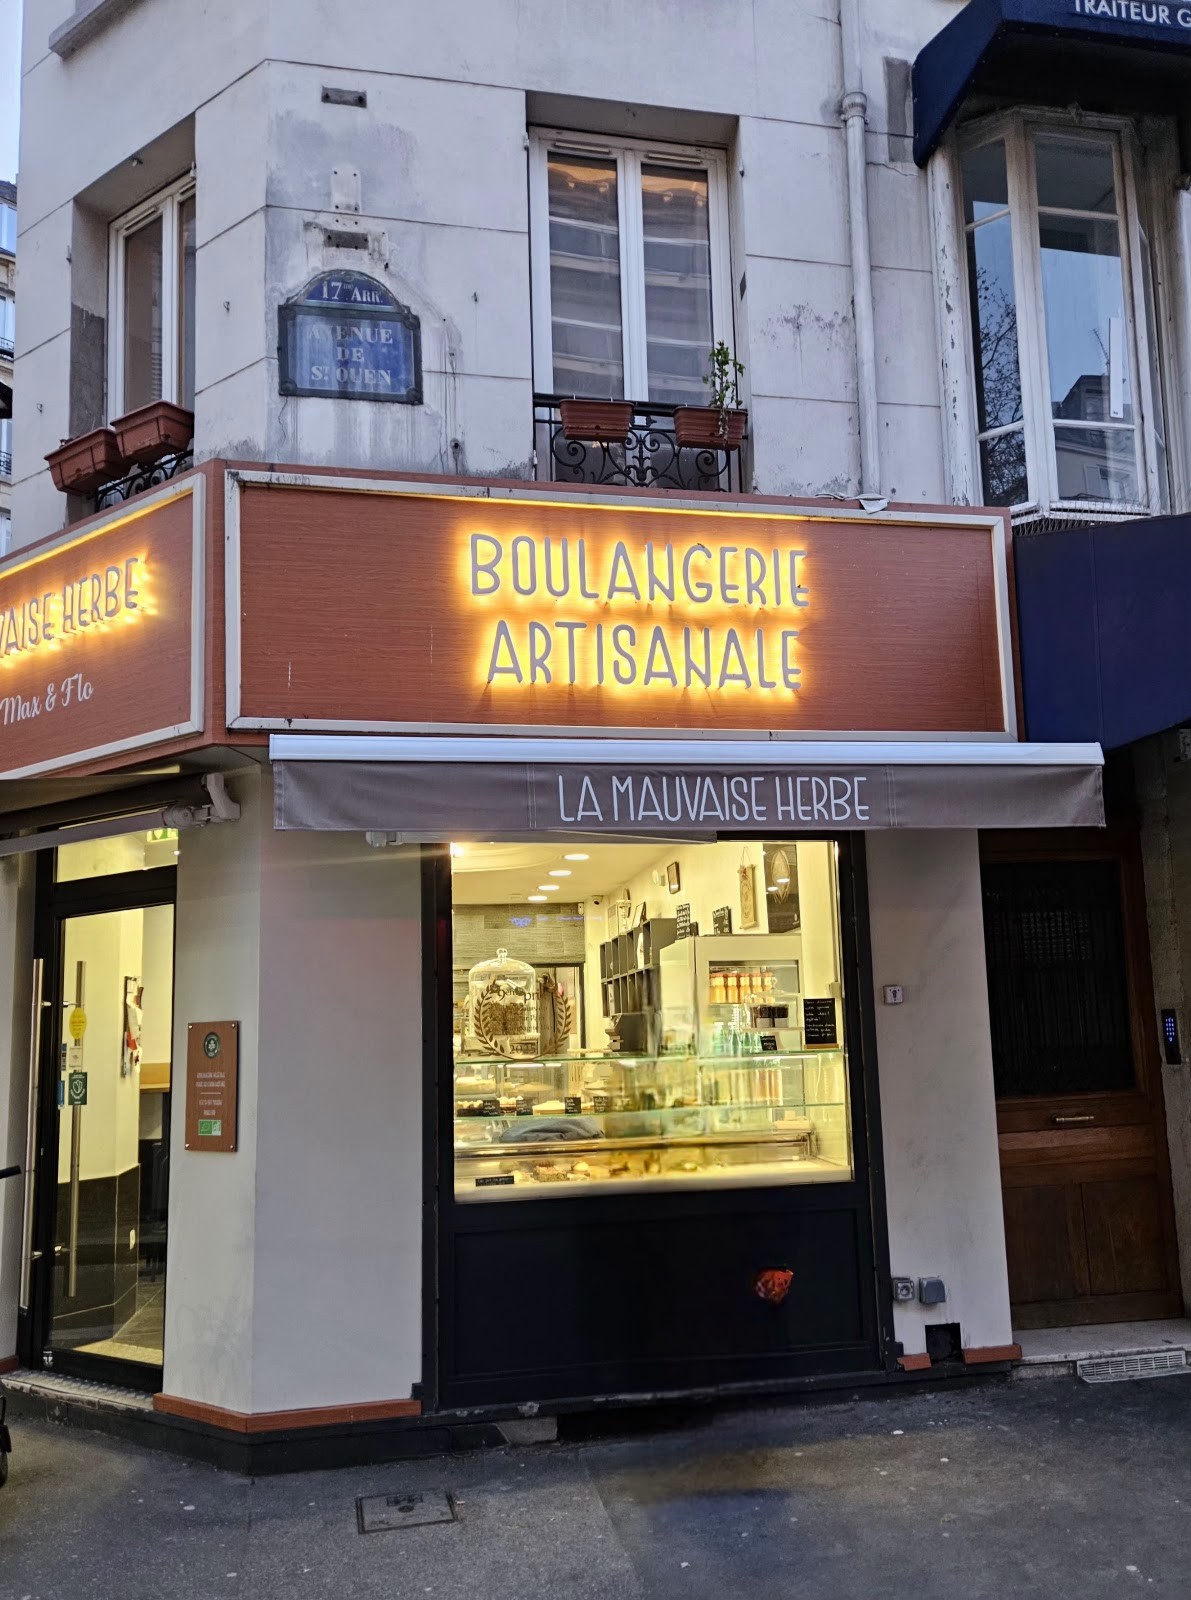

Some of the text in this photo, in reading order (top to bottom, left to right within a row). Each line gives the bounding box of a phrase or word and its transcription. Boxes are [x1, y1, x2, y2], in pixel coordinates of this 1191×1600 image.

[1074, 0, 1172, 24] TRAITEUR
[335, 367, 392, 386] OUEN
[336, 346, 365, 361] DE
[470, 533, 810, 607] BOULANGERIE
[62, 557, 139, 633] HERBE
[487, 620, 802, 689] ARTISANALE
[0, 673, 94, 725] Max & Flo
[558, 775, 870, 821] LA MAUVAISE HERBE
